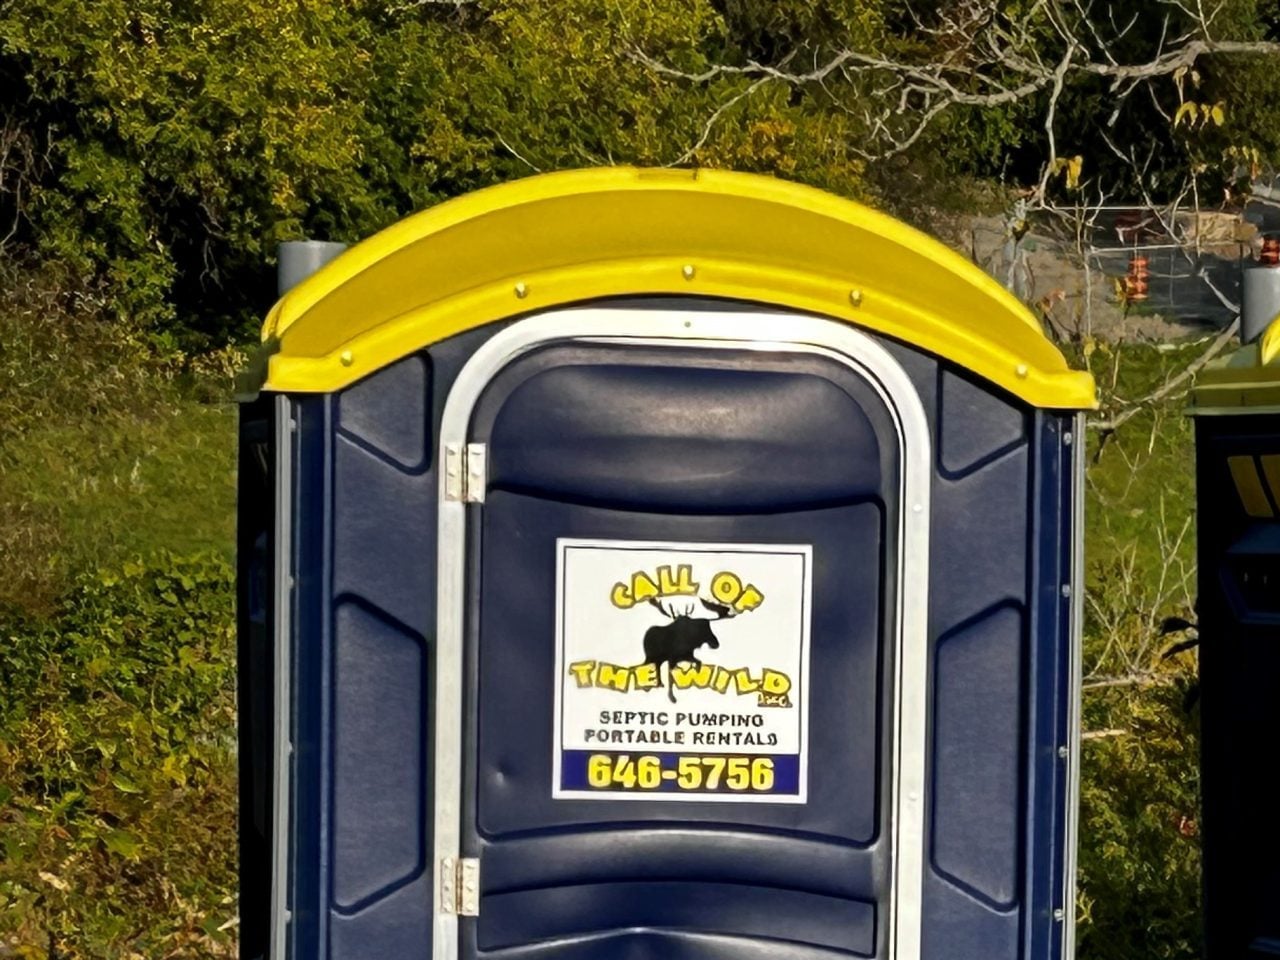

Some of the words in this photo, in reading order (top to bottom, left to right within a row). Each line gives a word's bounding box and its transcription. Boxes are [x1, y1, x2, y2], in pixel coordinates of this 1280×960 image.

[610, 564, 699, 609] CALL
[710, 571, 764, 613] OF
[569, 660, 660, 692] THE
[671, 661, 792, 695] WILD
[599, 711, 669, 726] SEPTIC
[675, 712, 764, 727] PUMPING
[584, 729, 685, 745] PORTABLE
[692, 731, 778, 746] RENTALS
[587, 754, 774, 790] 646-5756
